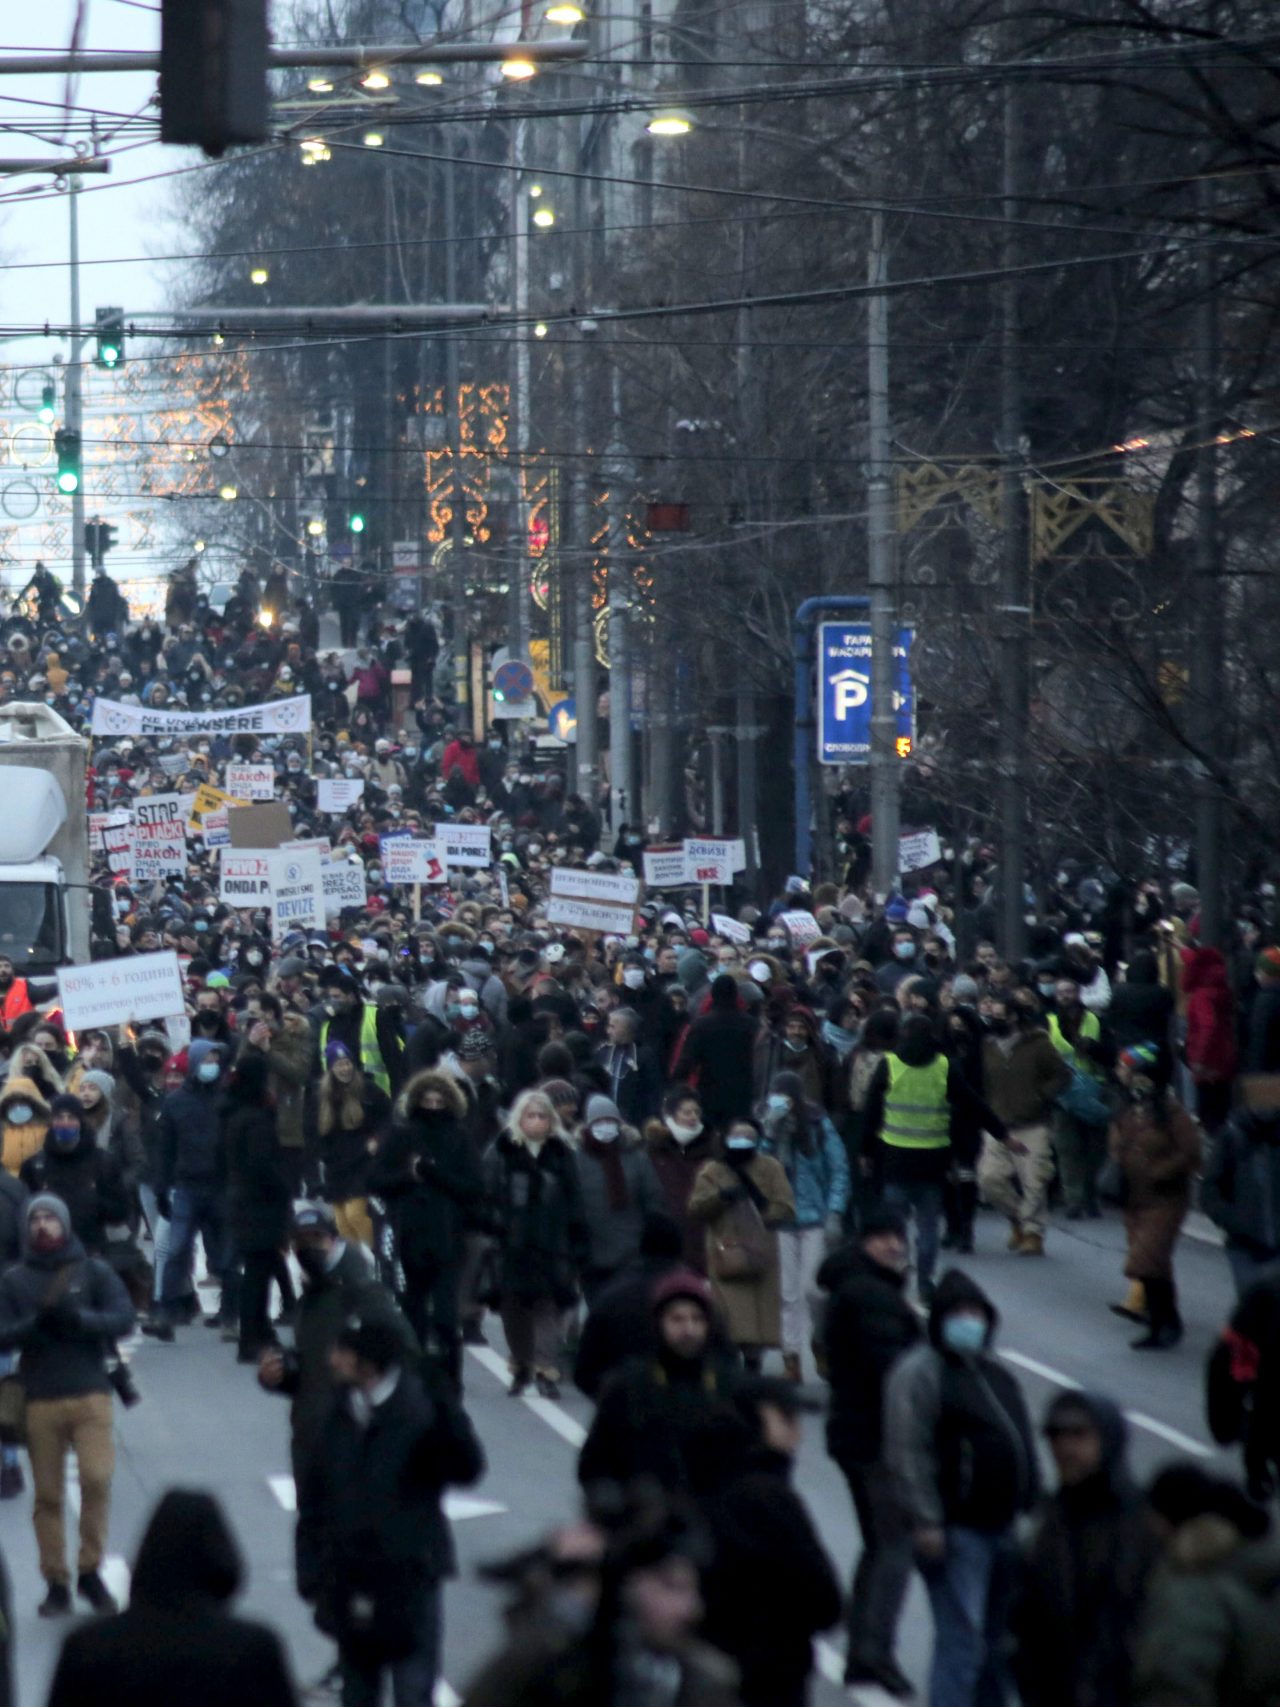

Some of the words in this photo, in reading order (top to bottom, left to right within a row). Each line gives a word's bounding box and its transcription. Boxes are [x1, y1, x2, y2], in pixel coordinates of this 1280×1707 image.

[835, 681, 868, 721] P
[230, 772, 272, 782] ЗАКОН
[138, 801, 179, 825] STOP
[135, 847, 181, 859] ЗАКОН
[224, 880, 258, 894] ONDA
[259, 880, 271, 894] P
[277, 897, 315, 918] DEVIZE
[64, 975, 94, 993] 80%
[111, 974, 120, 987] 6
[123, 967, 175, 985] година
